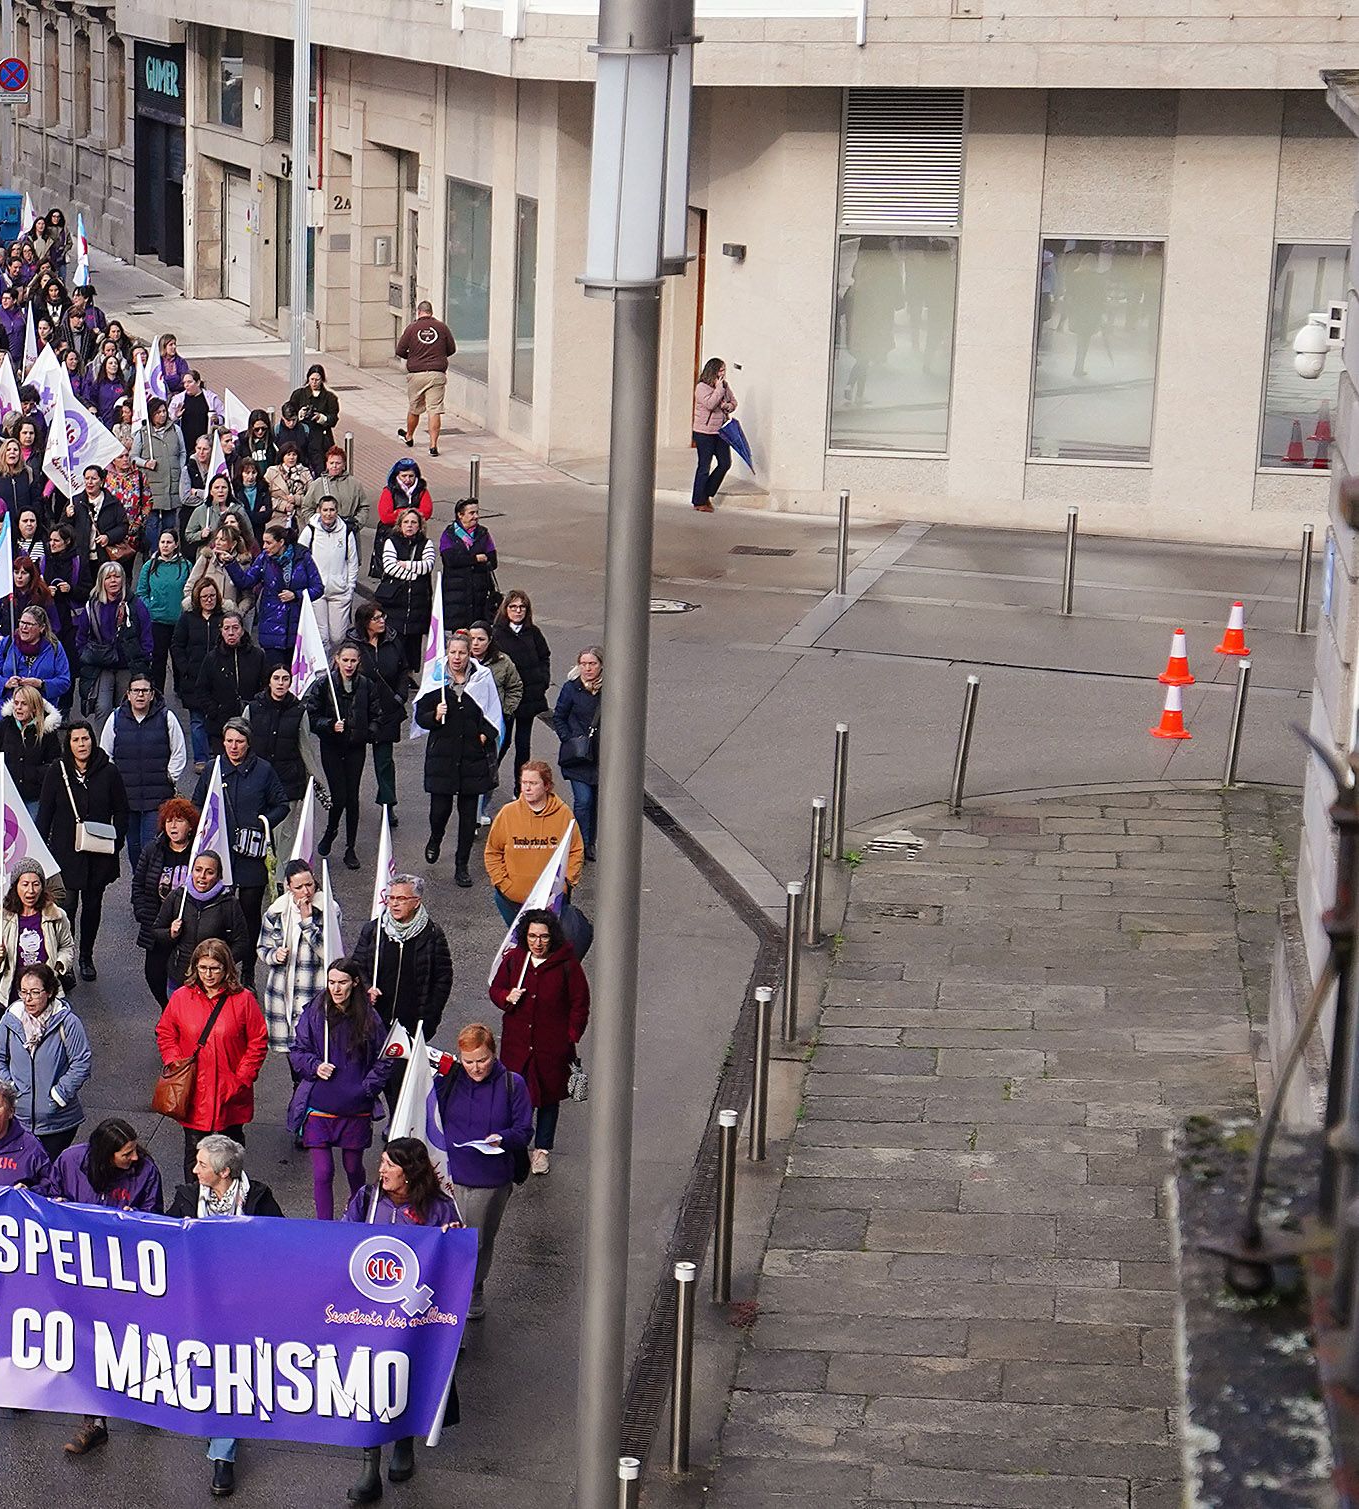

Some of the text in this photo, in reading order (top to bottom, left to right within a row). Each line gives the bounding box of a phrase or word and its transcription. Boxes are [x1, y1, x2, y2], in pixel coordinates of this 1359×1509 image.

[333, 195, 352, 210] 2A
[366, 1258, 404, 1281] CIG
[384, 1309, 407, 1329] das
[11, 1307, 75, 1373] CO
[93, 1319, 411, 1424] MACHISMO
